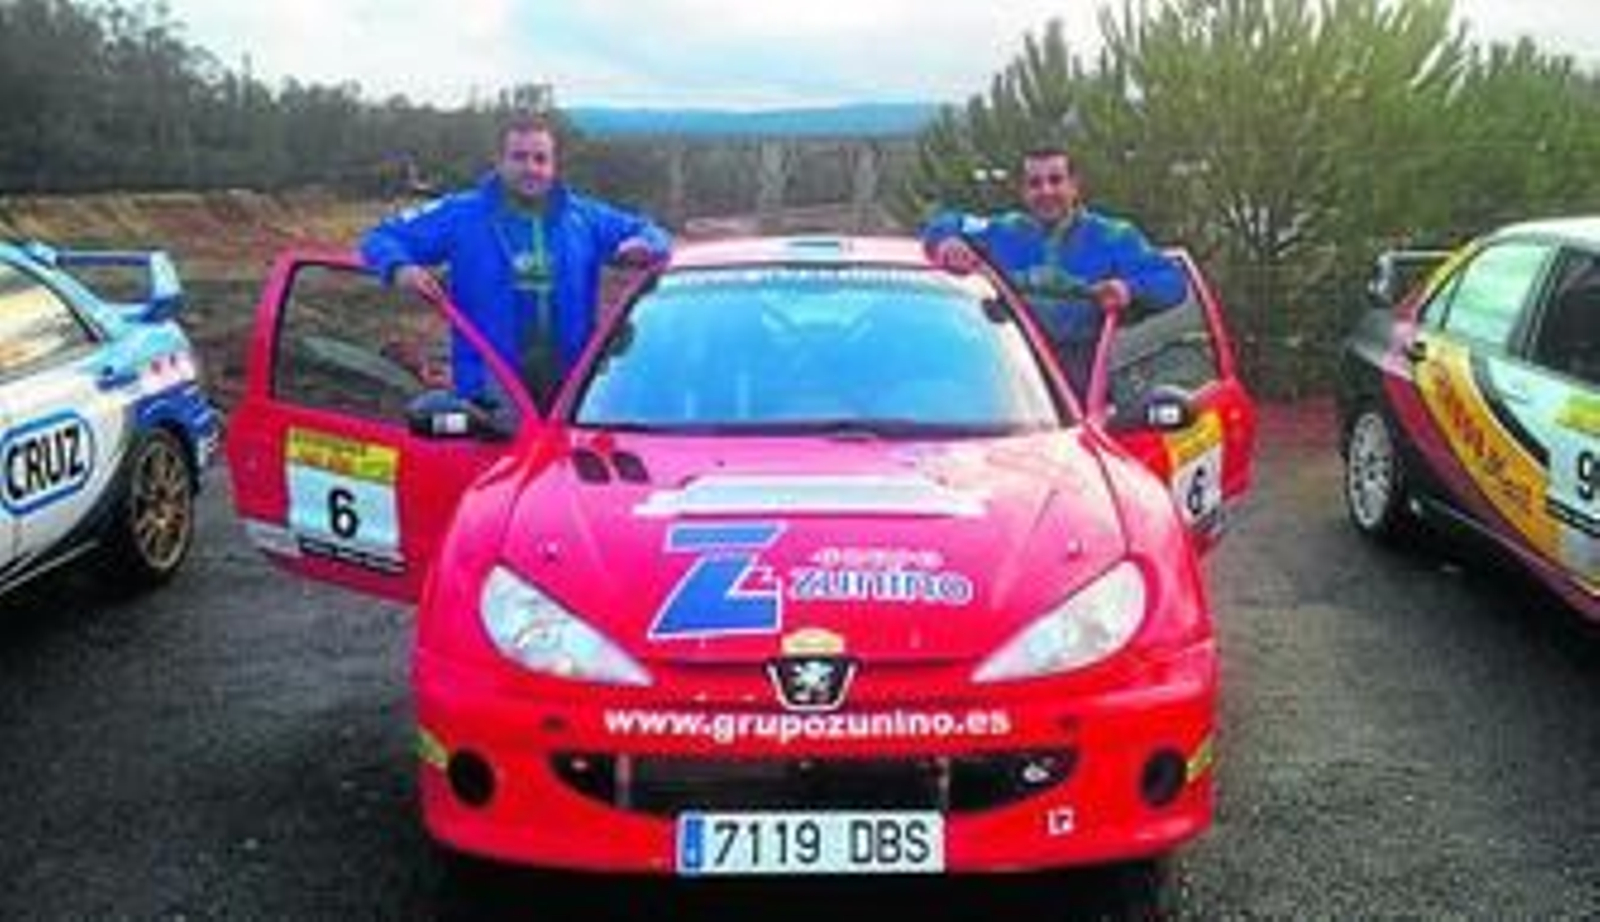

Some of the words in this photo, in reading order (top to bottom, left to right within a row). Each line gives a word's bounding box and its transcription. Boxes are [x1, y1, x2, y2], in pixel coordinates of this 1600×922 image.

[4, 424, 85, 500] CRUZ
[328, 488, 359, 539] 6
[1186, 466, 1206, 515] 6
[604, 707, 1011, 743] www.grupozunino.es
[712, 820, 822, 865] 7119
[850, 821, 931, 865] DBS
